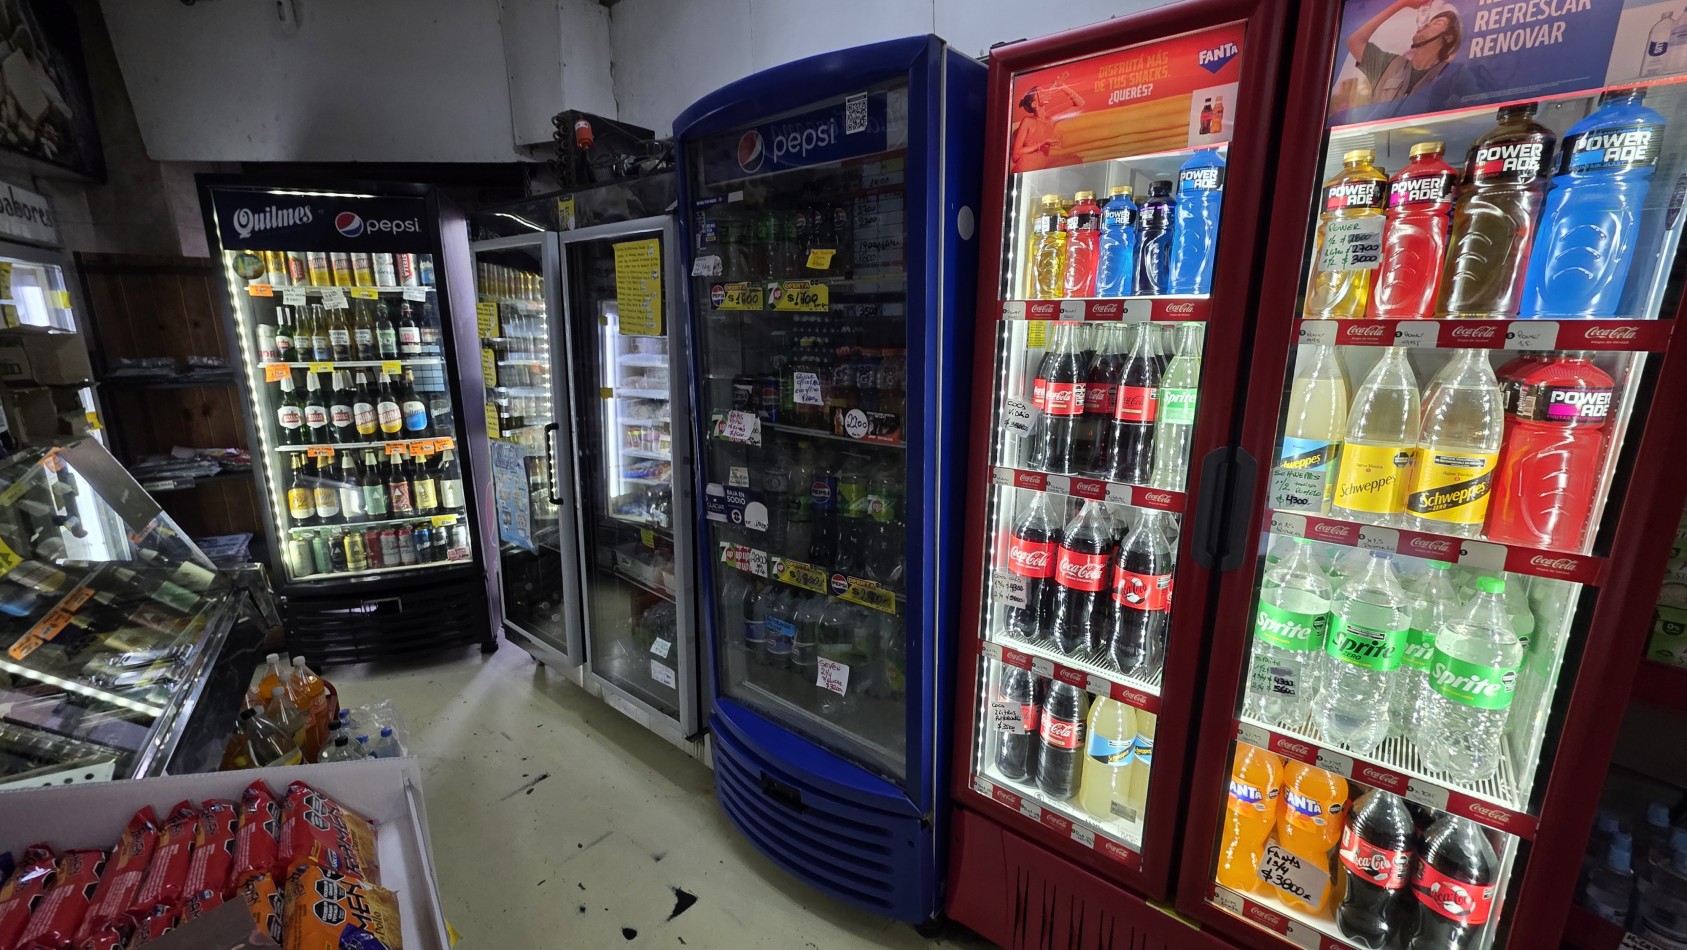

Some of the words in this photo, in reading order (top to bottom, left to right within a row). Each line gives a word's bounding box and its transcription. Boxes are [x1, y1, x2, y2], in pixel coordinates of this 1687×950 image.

[1474, 0, 1593, 33] REFRESCAR
[1469, 22, 1567, 60] RENOVAR
[1198, 42, 1239, 66] FANTA
[1098, 54, 1144, 79] DISFRUTÁ
[1146, 50, 1168, 69] MÁS
[1094, 80, 1106, 92] DE
[1108, 74, 1127, 90] TUS
[1129, 65, 1171, 86] SNACKS.
[1108, 83, 1154, 105] ¿QUERÉS?
[773, 118, 836, 164] pepsi
[1573, 131, 1652, 153] POWER
[1476, 144, 1543, 162] POWER
[1604, 146, 1648, 162] ADE
[1503, 159, 1540, 171] ADE
[1180, 170, 1217, 182] POWER
[1193, 179, 1217, 189] ADE
[1329, 184, 1376, 199] POWER
[1389, 178, 1443, 193] POWER
[1347, 195, 1374, 206] ADE
[1408, 189, 1438, 201] ADE
[0, 186, 54, 228] abores
[1105, 211, 1131, 219] POWER
[233, 204, 313, 240] Quilmes
[366, 217, 422, 236] pepsi
[1115, 217, 1130, 225] ADE
[1328, 222, 1361, 233] POWER
[1091, 304, 1116, 313] Coca-Cola
[1165, 303, 1193, 313] Coca-Cola
[1346, 325, 1383, 337] Coca-Cola
[1450, 325, 1494, 338] Coca-Cola
[1583, 325, 1637, 340] Coca-Cola
[1164, 391, 1197, 403] Sprite
[1550, 390, 1612, 405] POWER
[1580, 404, 1610, 417] ADE
[846, 413, 868, 429] 2200
[811, 489, 830, 497] PEPSI
[1076, 482, 1101, 493] Coca-Cola
[1339, 474, 1396, 497] Schweppes
[726, 496, 746, 505] SODIO
[1145, 492, 1171, 504] Coca-Cola
[1419, 481, 1486, 508] Schweppes
[1432, 503, 1447, 511] ZERO
[1315, 523, 1350, 537] Coca-Cola
[1410, 536, 1450, 553] Coca-Cola
[1010, 545, 1048, 567] Coca-Cola
[1530, 555, 1577, 571] Coca-Cola
[1059, 556, 1105, 580] Coca-Cola
[832, 580, 848, 588] PEPSI
[1257, 611, 1312, 640] Sprite
[1332, 632, 1395, 661] Sprite
[1342, 651, 1362, 661] ZERO
[1432, 662, 1500, 697] Sprite
[1277, 738, 1309, 755] Coca-Cola
[1362, 767, 1398, 786] Coca-Cola
[1229, 780, 1262, 800] ANTA
[1284, 785, 1322, 814] FANTA
[1468, 803, 1511, 823] Coca-Cola
[372, 911, 385, 935] Pollo
